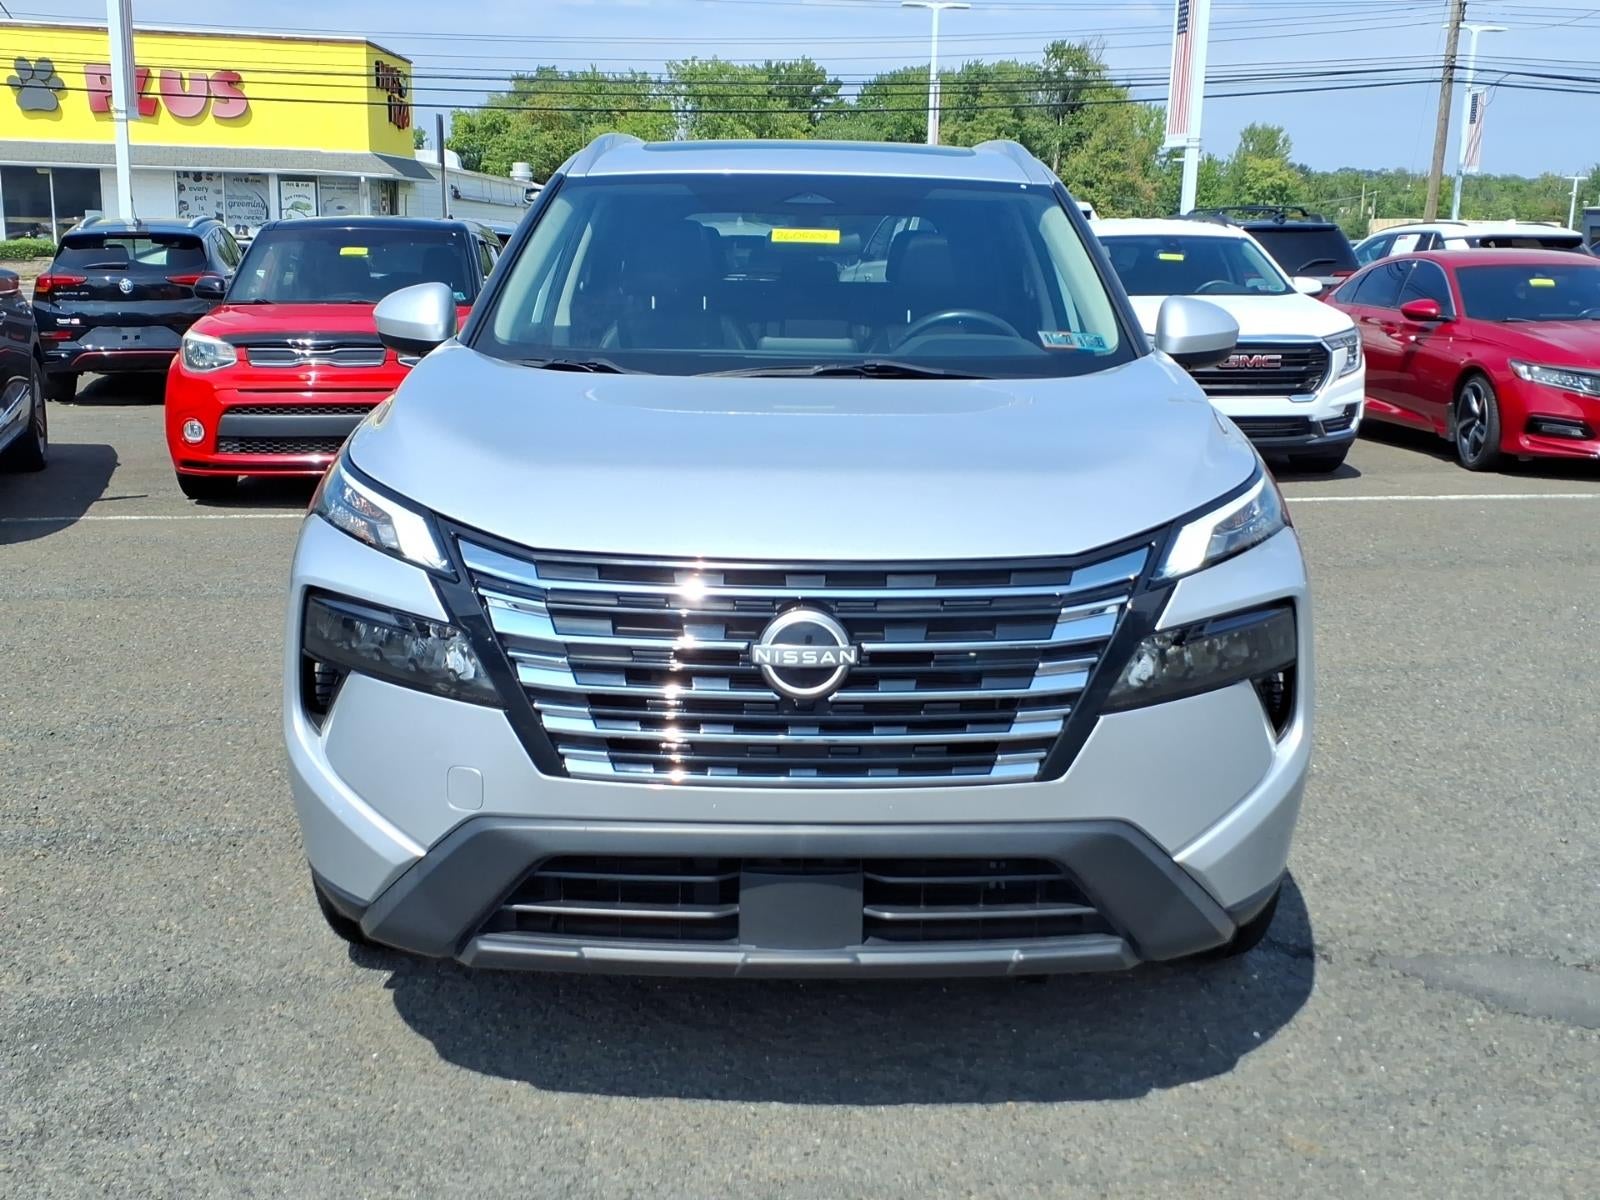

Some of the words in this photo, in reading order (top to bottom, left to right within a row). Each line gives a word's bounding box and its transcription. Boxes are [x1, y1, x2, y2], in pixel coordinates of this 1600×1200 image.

[84, 63, 249, 119] PLUS
[228, 199, 266, 210] grooming
[1219, 354, 1283, 368] GMC
[755, 649, 856, 665] NISSAN
